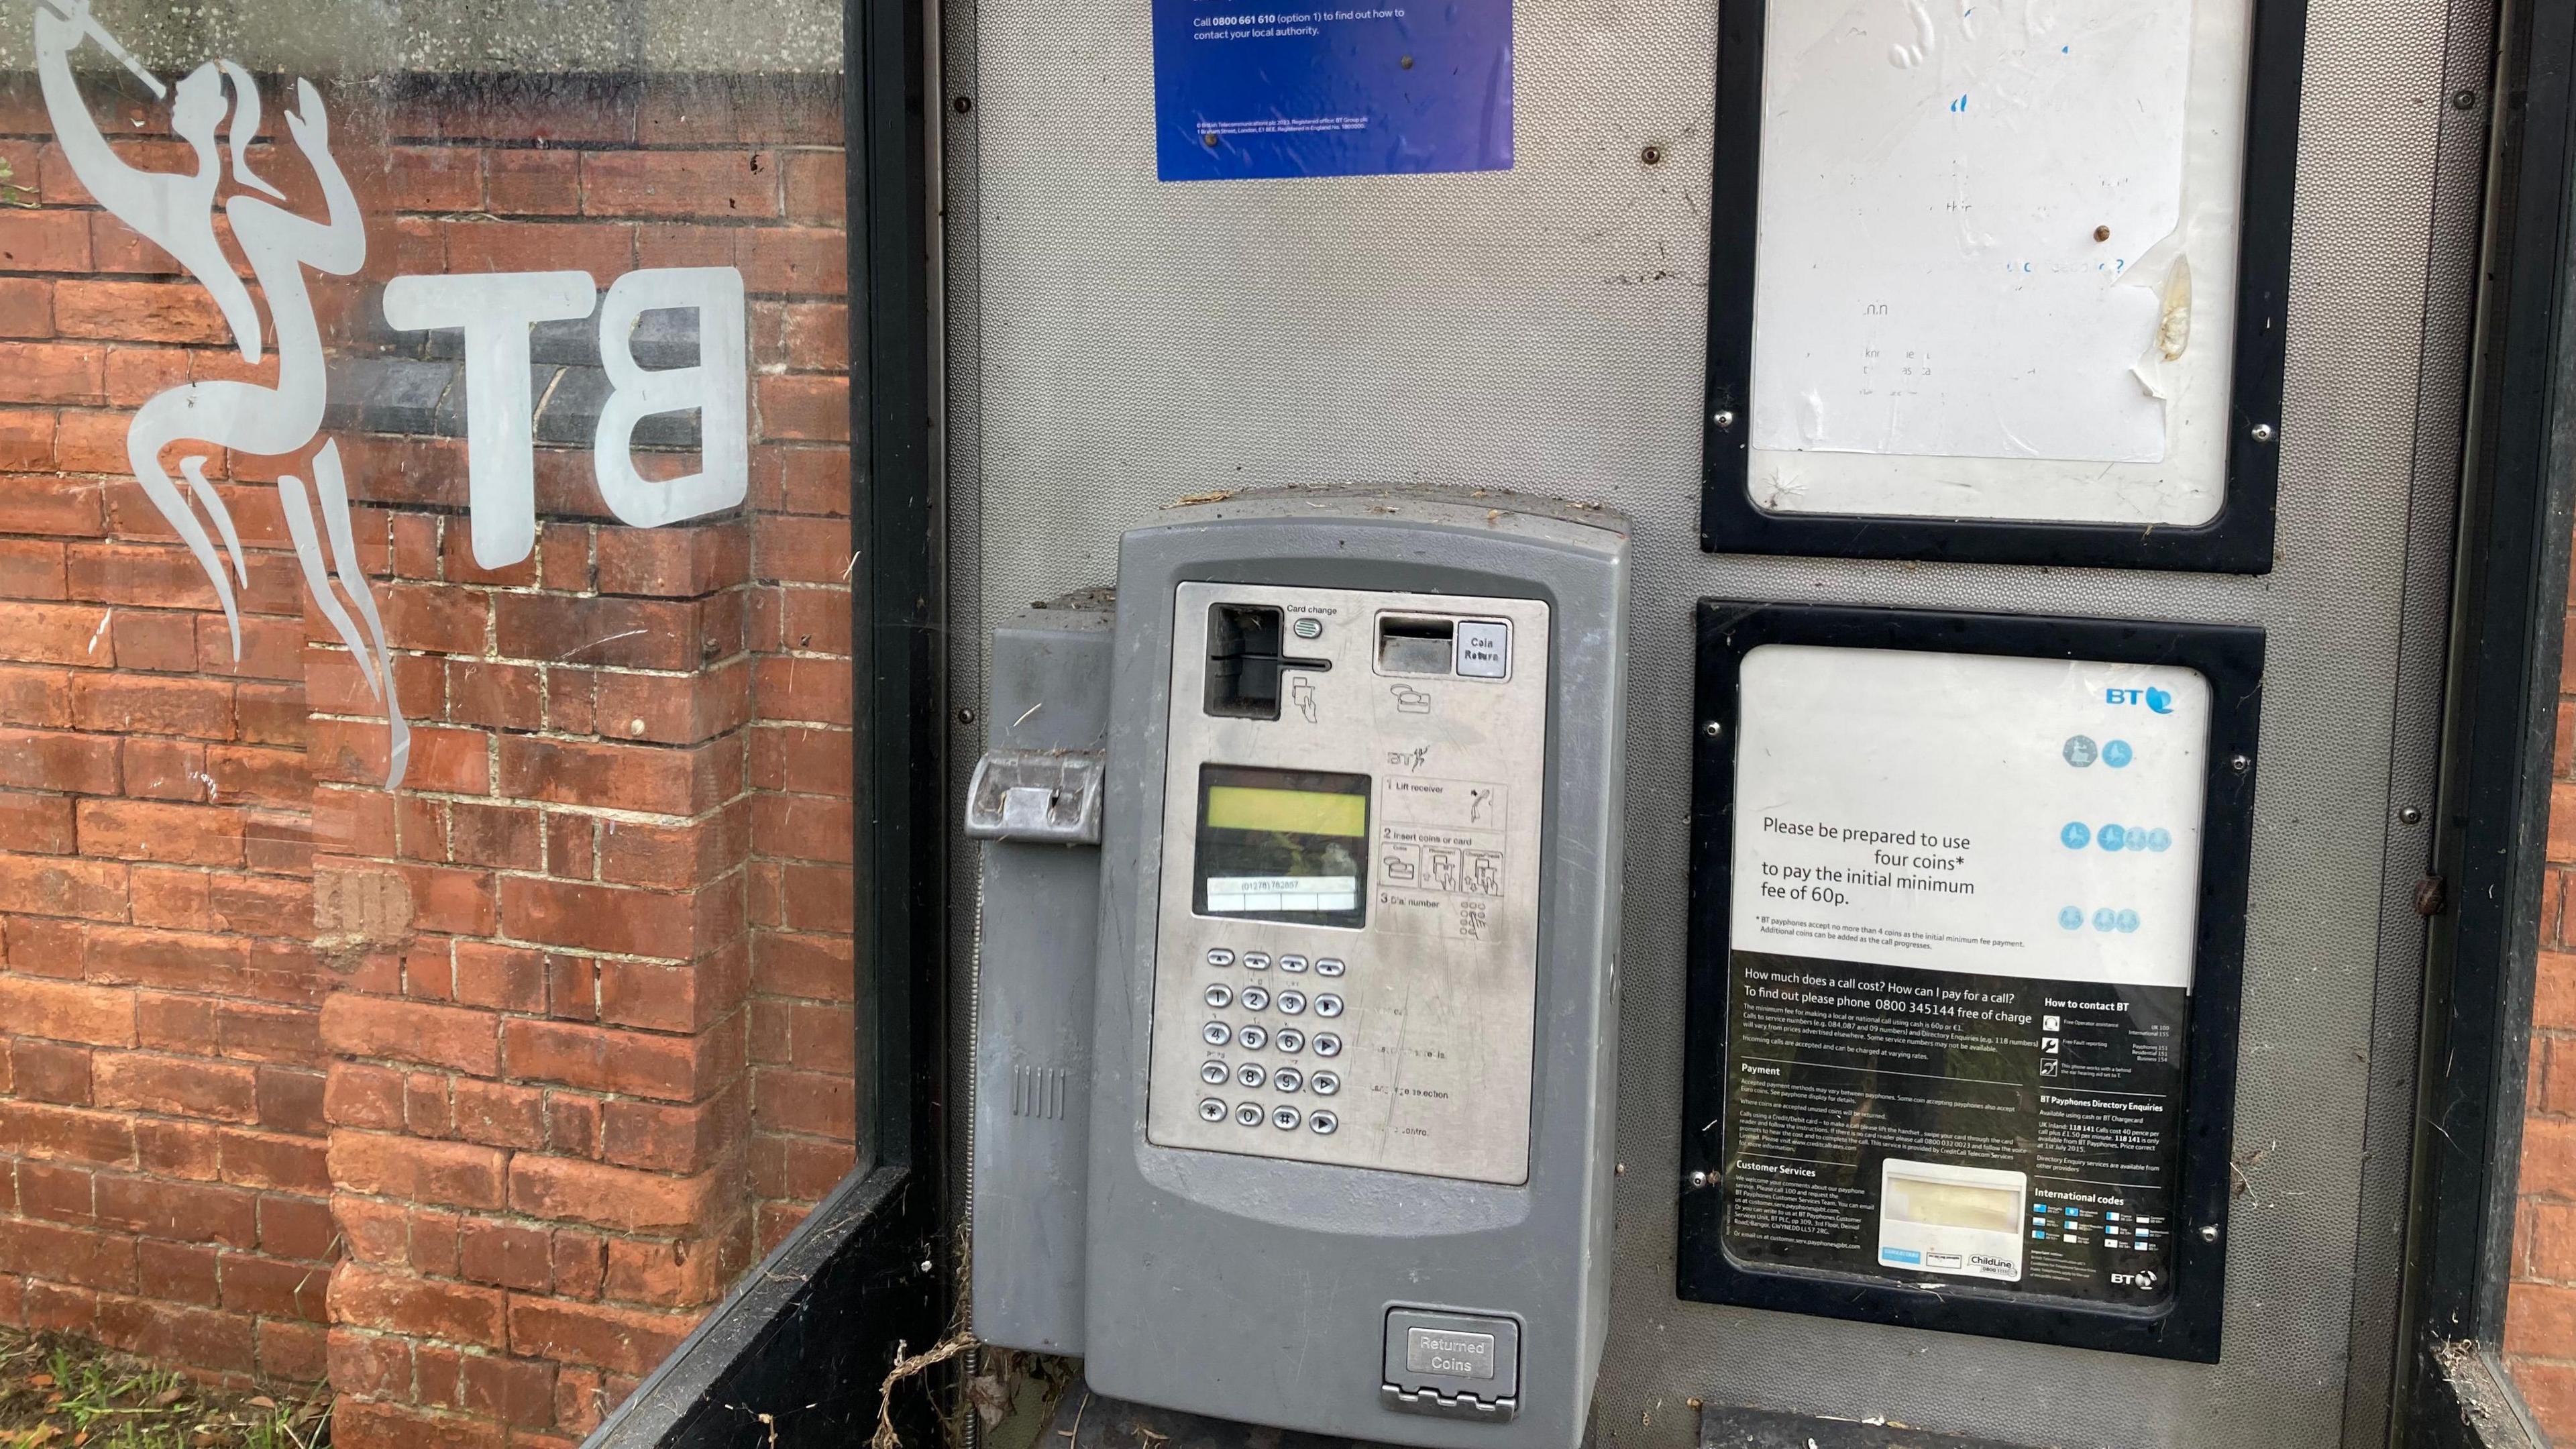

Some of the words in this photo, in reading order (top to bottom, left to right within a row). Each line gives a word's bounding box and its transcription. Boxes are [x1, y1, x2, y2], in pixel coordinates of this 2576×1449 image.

[1193, 18, 1210, 28] Call
[1212, 17, 1237, 26] 0800
[1238, 16, 1254, 25] 661
[1258, 15, 1275, 24] 610
[1277, 13, 1309, 26] (option
[1313, 13, 1321, 24] 1)
[1324, 13, 1333, 21] to
[1335, 11, 1353, 20] find
[1355, 11, 1371, 19] out
[1373, 9, 1393, 18] how
[1395, 9, 1404, 17] to
[1193, 31, 1228, 40] contact
[1230, 32, 1250, 41] your
[1252, 28, 1273, 38] local
[1275, 27, 1319, 37] authority.
[1287, 605, 1306, 613] Card
[1307, 606, 1337, 616] change
[1470, 637, 1494, 649] Coin
[1464, 649, 1499, 661] Return
[2106, 688, 2144, 705] BT
[1387, 752, 1414, 765] BT
[1396, 782, 1409, 790] Lift
[1411, 784, 1444, 793] receiver
[1384, 828, 1391, 839] 2
[1393, 832, 1416, 842] Insert
[1419, 834, 1440, 843] coins
[1454, 837, 1472, 846] card
[1764, 818, 1813, 835] Please
[1819, 822, 1837, 837] be
[1843, 828, 1915, 845] prepared
[1921, 832, 1937, 846] to
[1943, 836, 1970, 849] use
[1874, 850, 1909, 867] four
[1762, 861, 1778, 875] to
[1783, 866, 1811, 883] pay
[1815, 866, 1841, 881] the
[1847, 868, 1890, 886] initial
[1897, 874, 1974, 894] minimum
[1381, 892, 1388, 904] 3
[1408, 899, 1440, 908] number
[1761, 883, 1785, 898] fee
[1790, 886, 1807, 900] of
[1812, 888, 1848, 908] 60p.
[1760, 925, 1794, 935] Additional
[1796, 929, 1813, 937] coins
[1837, 933, 1858, 941] added
[1894, 940, 1931, 949] progresses.
[1771, 918, 1807, 926] payphones
[1808, 922, 1829, 930] accept
[1861, 925, 1876, 933] than
[1925, 931, 1944, 939] initial
[1945, 934, 1978, 943] minimum
[1980, 936, 1990, 944] fee
[1992, 938, 2023, 947] payment.
[1745, 967, 1768, 980] How
[1771, 972, 1799, 983] much
[1802, 973, 1826, 985] does
[1829, 978, 1835, 986] a
[1837, 977, 1855, 988] call
[1858, 980, 1885, 991] cost?
[1888, 981, 1912, 994] How
[1915, 986, 1933, 996] can
[1936, 986, 1939, 996] I
[1942, 989, 1961, 1002] pay
[1964, 989, 1979, 1000] for
[1982, 993, 1988, 1001] a
[1990, 992, 2015, 1004] call?
[1216, 991, 1220, 1003] 1
[1250, 994, 1258, 1006] 2
[1285, 997, 1293, 1010] 3
[1746, 985, 1756, 997] To
[1758, 987, 1778, 999] find
[1781, 991, 1799, 1001] out
[1802, 991, 1834, 1005] please
[1837, 995, 1870, 1008] phone
[1875, 998, 1905, 1011] 0800
[1909, 1001, 1953, 1016] 345144
[1957, 1006, 1978, 1018] free
[1981, 1009, 1993, 1020] of
[1995, 1010, 2031, 1026] charge
[2045, 998, 2065, 1007] How
[2079, 1002, 2114, 1010] contact
[2116, 1002, 2129, 1011] BT
[1212, 1028, 1220, 1041] 4
[1247, 1032, 1255, 1045] 5
[1285, 1036, 1293, 1048] 6
[1210, 1068, 1217, 1080] 7
[1246, 1071, 1254, 1083] 8
[1282, 1075, 1290, 1087] 9
[1741, 1063, 1780, 1076] Payment
[2051, 1097, 2090, 1106] Payphones
[2092, 1099, 2127, 1110] Directory
[2129, 1102, 2162, 1112] Enquiries
[1244, 1111, 1252, 1122] 0
[1280, 1114, 1290, 1124] #
[2111, 1115, 2143, 1124] Chargecard
[1737, 1161, 1778, 1173] Customer
[1780, 1165, 1815, 1177] Services
[2035, 1188, 2095, 1202] International
[2097, 1195, 2123, 1205] codes
[1971, 1256, 2012, 1268] ChildLine
[2111, 1273, 2135, 1285] BT
[1420, 1336, 1485, 1354] Returned
[1431, 1356, 1472, 1372] Coins
